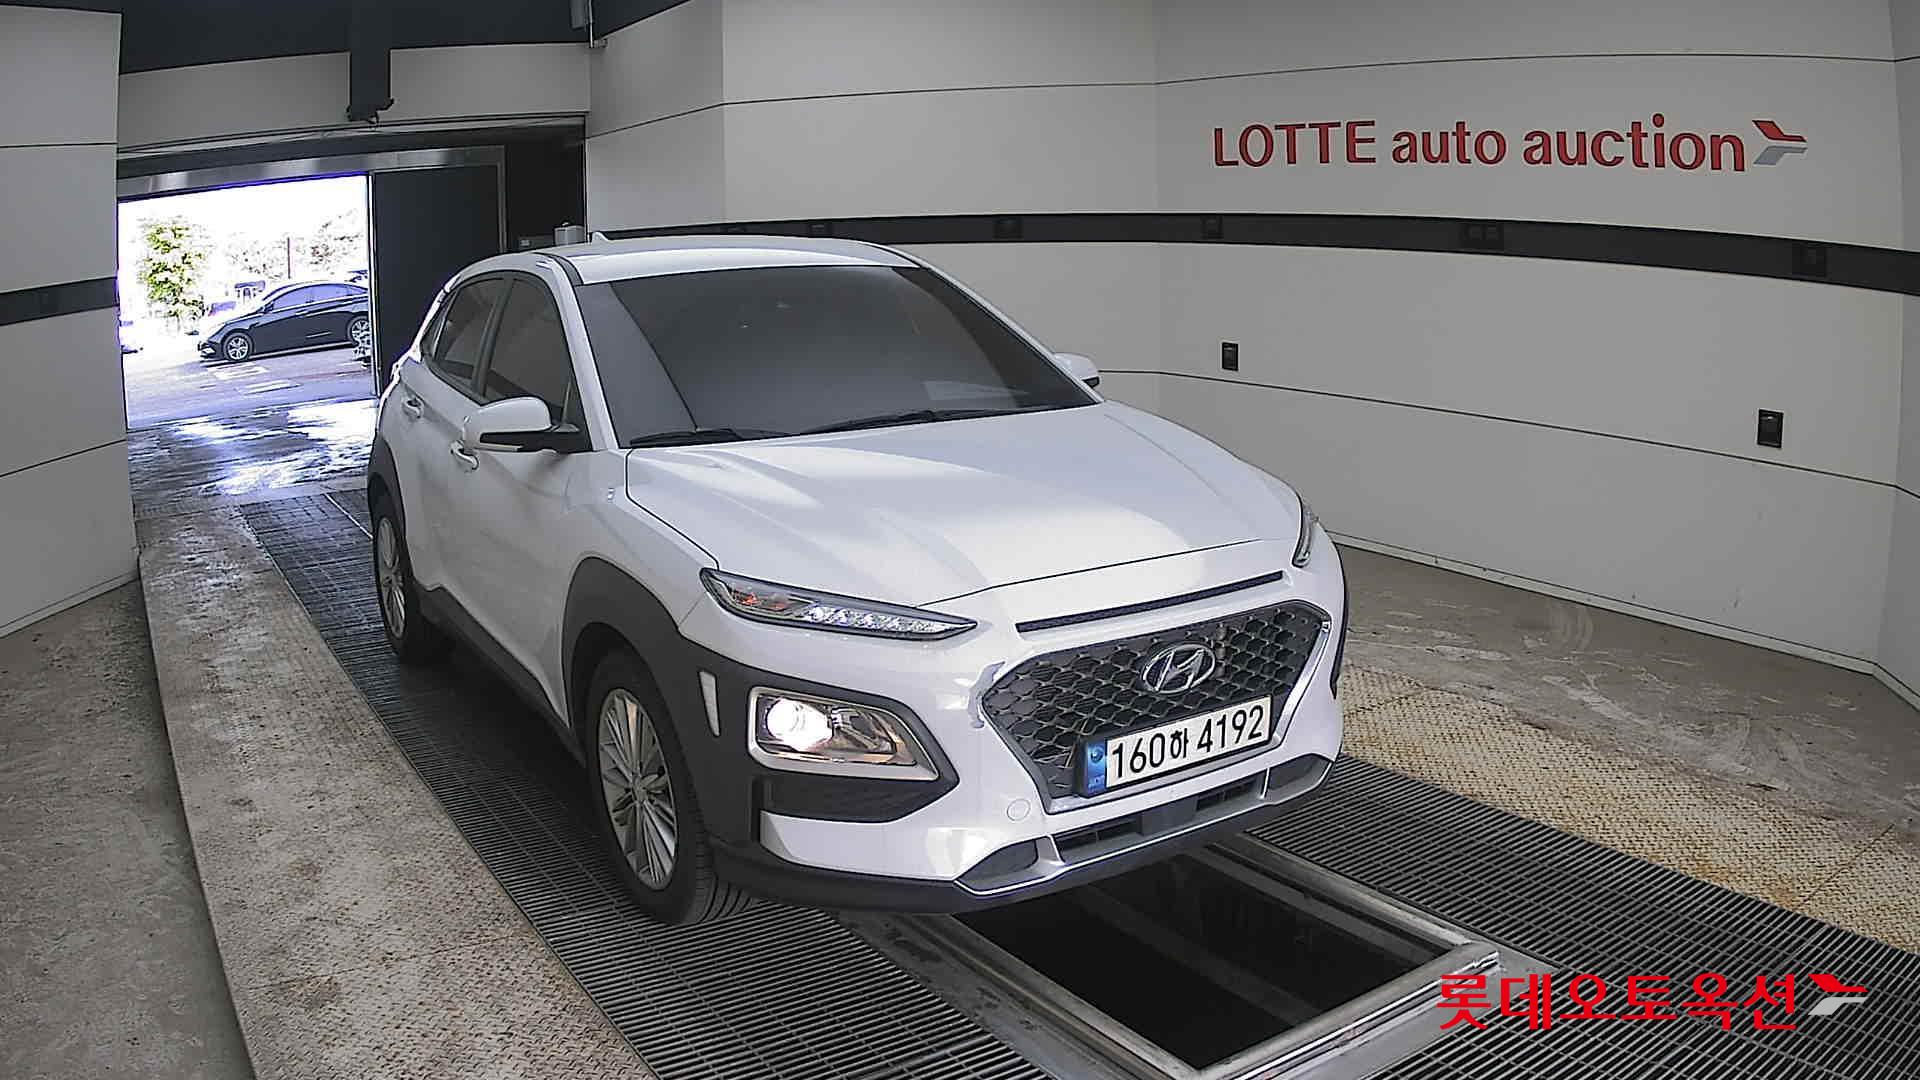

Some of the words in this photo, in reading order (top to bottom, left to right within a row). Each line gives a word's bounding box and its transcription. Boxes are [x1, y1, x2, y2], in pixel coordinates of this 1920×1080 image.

[1212, 119, 1377, 168] LOTTE
[1391, 120, 1507, 165] auto
[1522, 112, 1746, 173] auction
[1111, 727, 1190, 779] 160하
[1196, 704, 1265, 753] 4192
